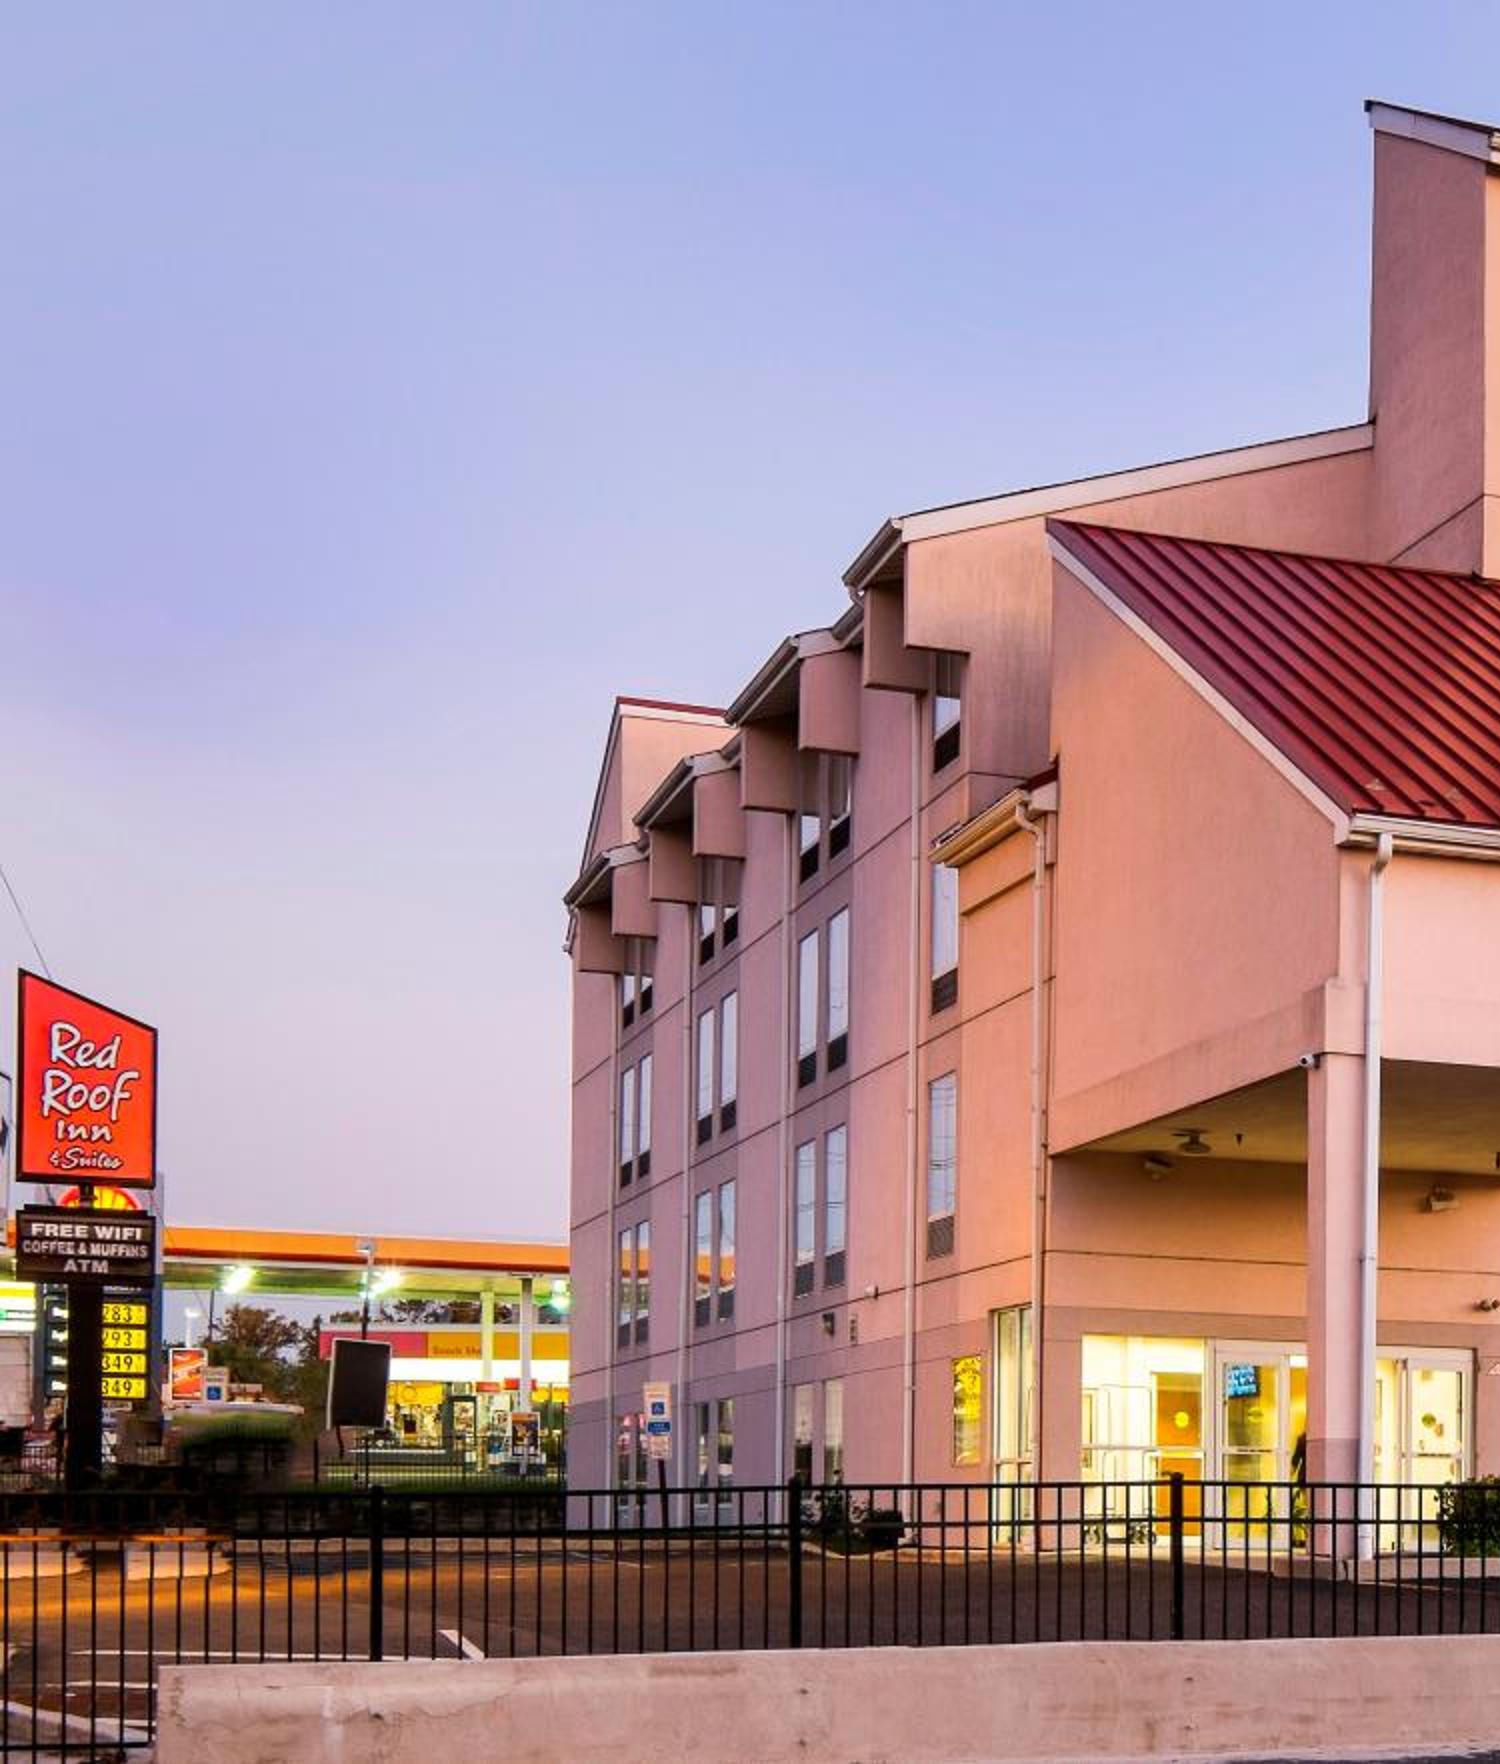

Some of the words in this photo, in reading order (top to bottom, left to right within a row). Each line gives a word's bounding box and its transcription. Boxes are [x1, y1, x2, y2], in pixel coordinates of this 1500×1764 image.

[51, 1021, 122, 1069] Red
[41, 1069, 140, 1121] Roof
[56, 1119, 112, 1141] Inn
[31, 1223, 89, 1238] FREE
[93, 1225, 142, 1240] WIFI
[22, 1239, 75, 1255] COFFEE
[77, 1241, 87, 1254] &
[89, 1241, 148, 1258] MUFFINS
[63, 1259, 109, 1273] ATM
